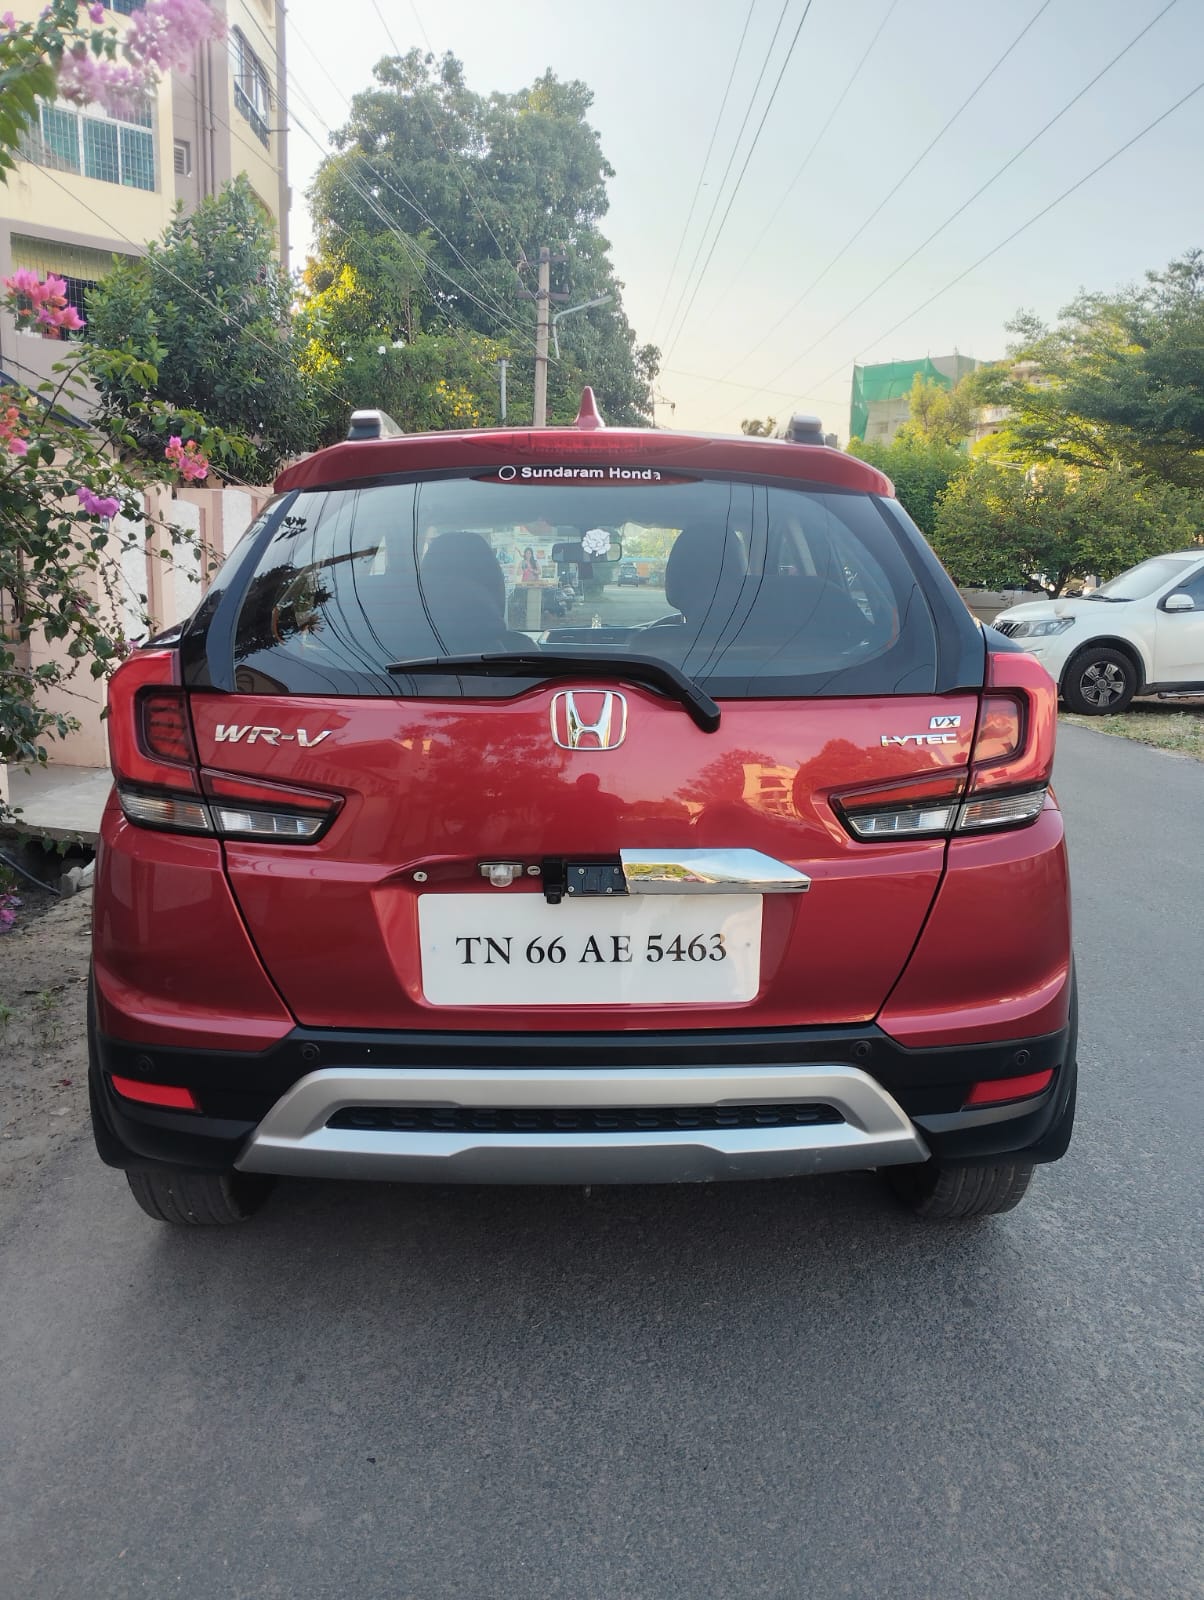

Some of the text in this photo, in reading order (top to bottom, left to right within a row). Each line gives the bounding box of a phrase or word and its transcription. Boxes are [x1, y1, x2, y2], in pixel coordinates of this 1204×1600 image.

[521, 466, 604, 478] Sundaram
[934, 717, 958, 727] VX
[214, 724, 332, 748] WR-V
[455, 933, 727, 964] TN 66 AE 5463
